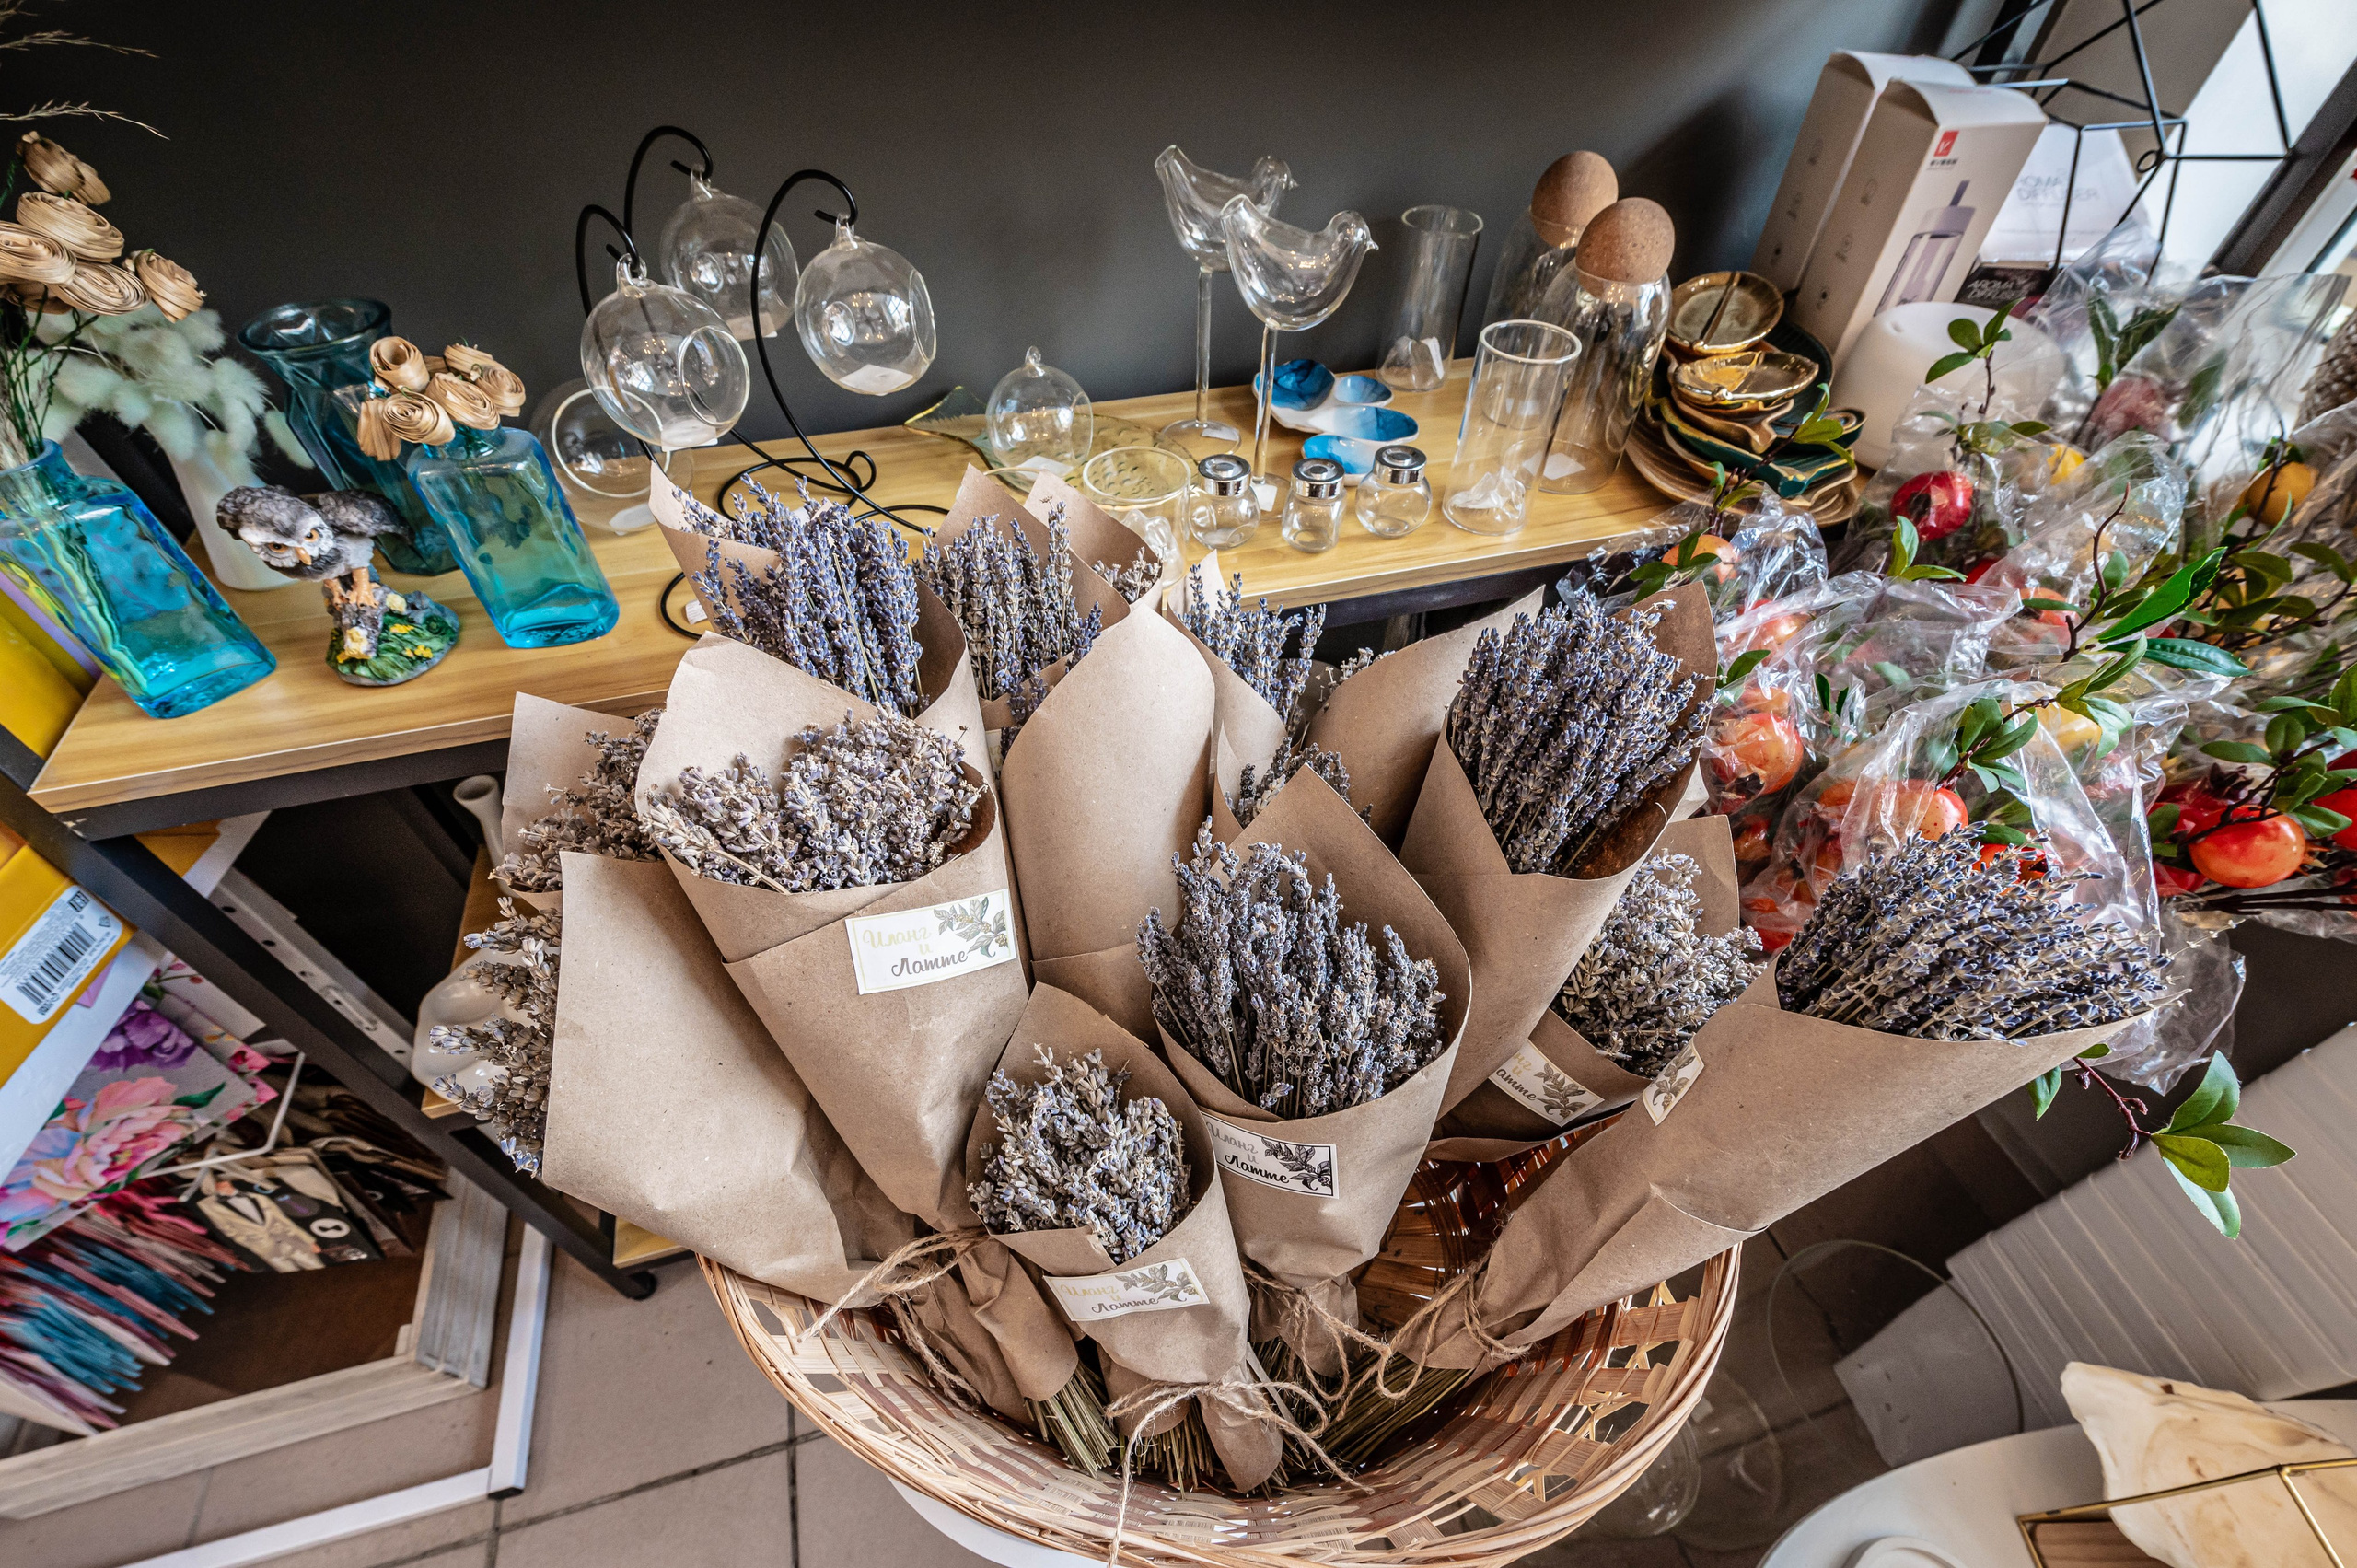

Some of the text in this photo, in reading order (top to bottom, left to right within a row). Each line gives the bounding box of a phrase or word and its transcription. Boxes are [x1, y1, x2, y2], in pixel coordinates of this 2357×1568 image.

[863, 926, 933, 949] Иланг
[919, 944, 934, 956] и
[890, 950, 969, 978] Латте
[1495, 1068, 1538, 1101] атте
[1225, 1154, 1290, 1184] Латте
[1060, 1283, 1120, 1297] Иланг
[1091, 1297, 1160, 1314] Латте
